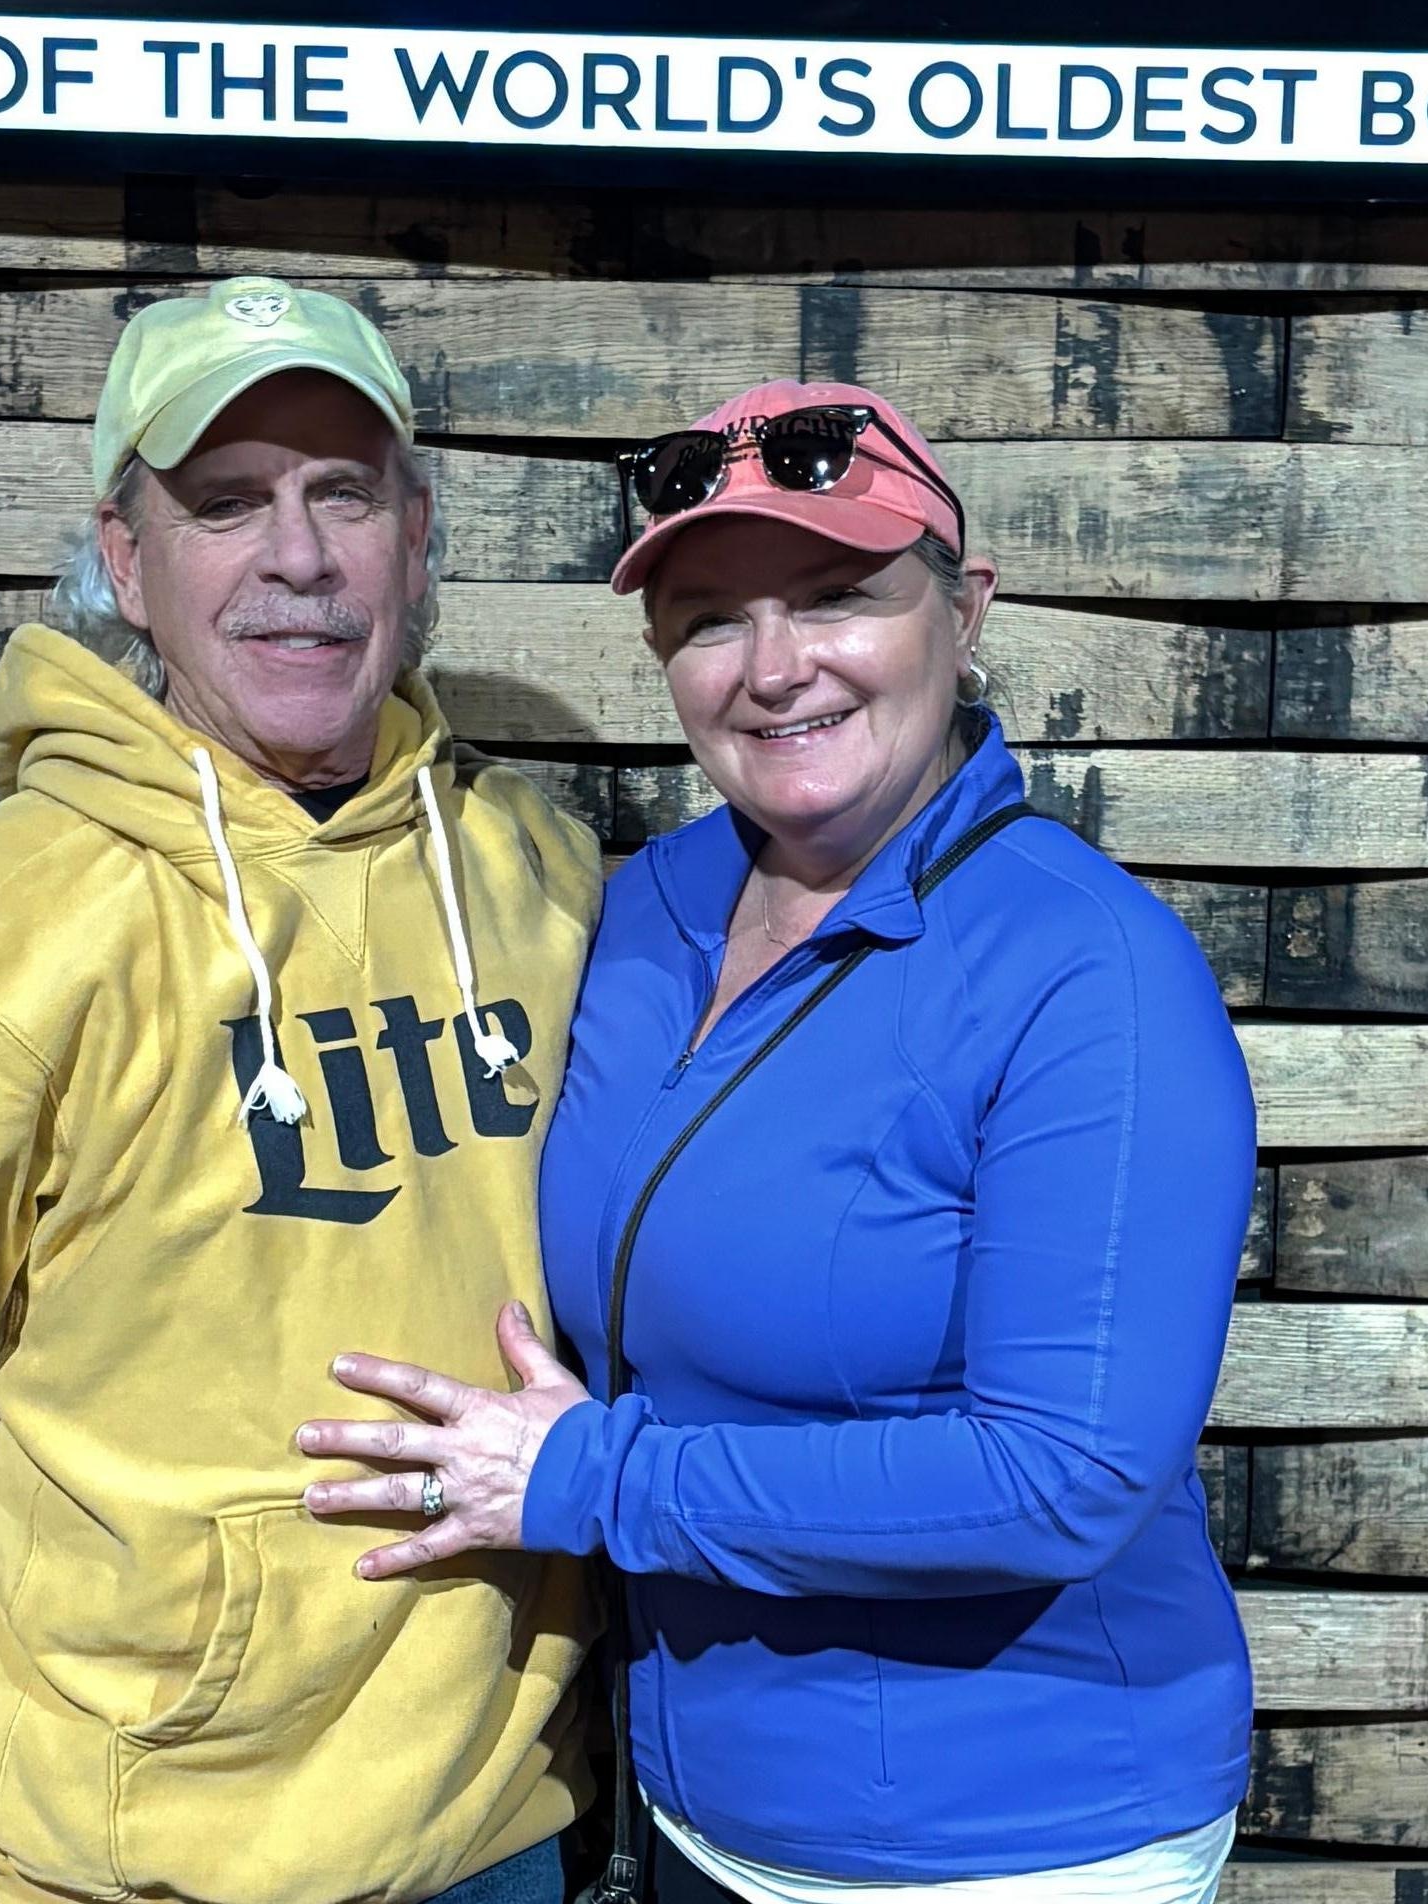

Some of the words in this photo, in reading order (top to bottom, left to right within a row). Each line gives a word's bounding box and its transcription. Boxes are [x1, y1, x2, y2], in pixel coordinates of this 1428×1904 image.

[143, 40, 349, 124] THE
[393, 47, 876, 137] WORLD'S
[908, 60, 1318, 145] OLDEST
[219, 994, 540, 1225] Lite
